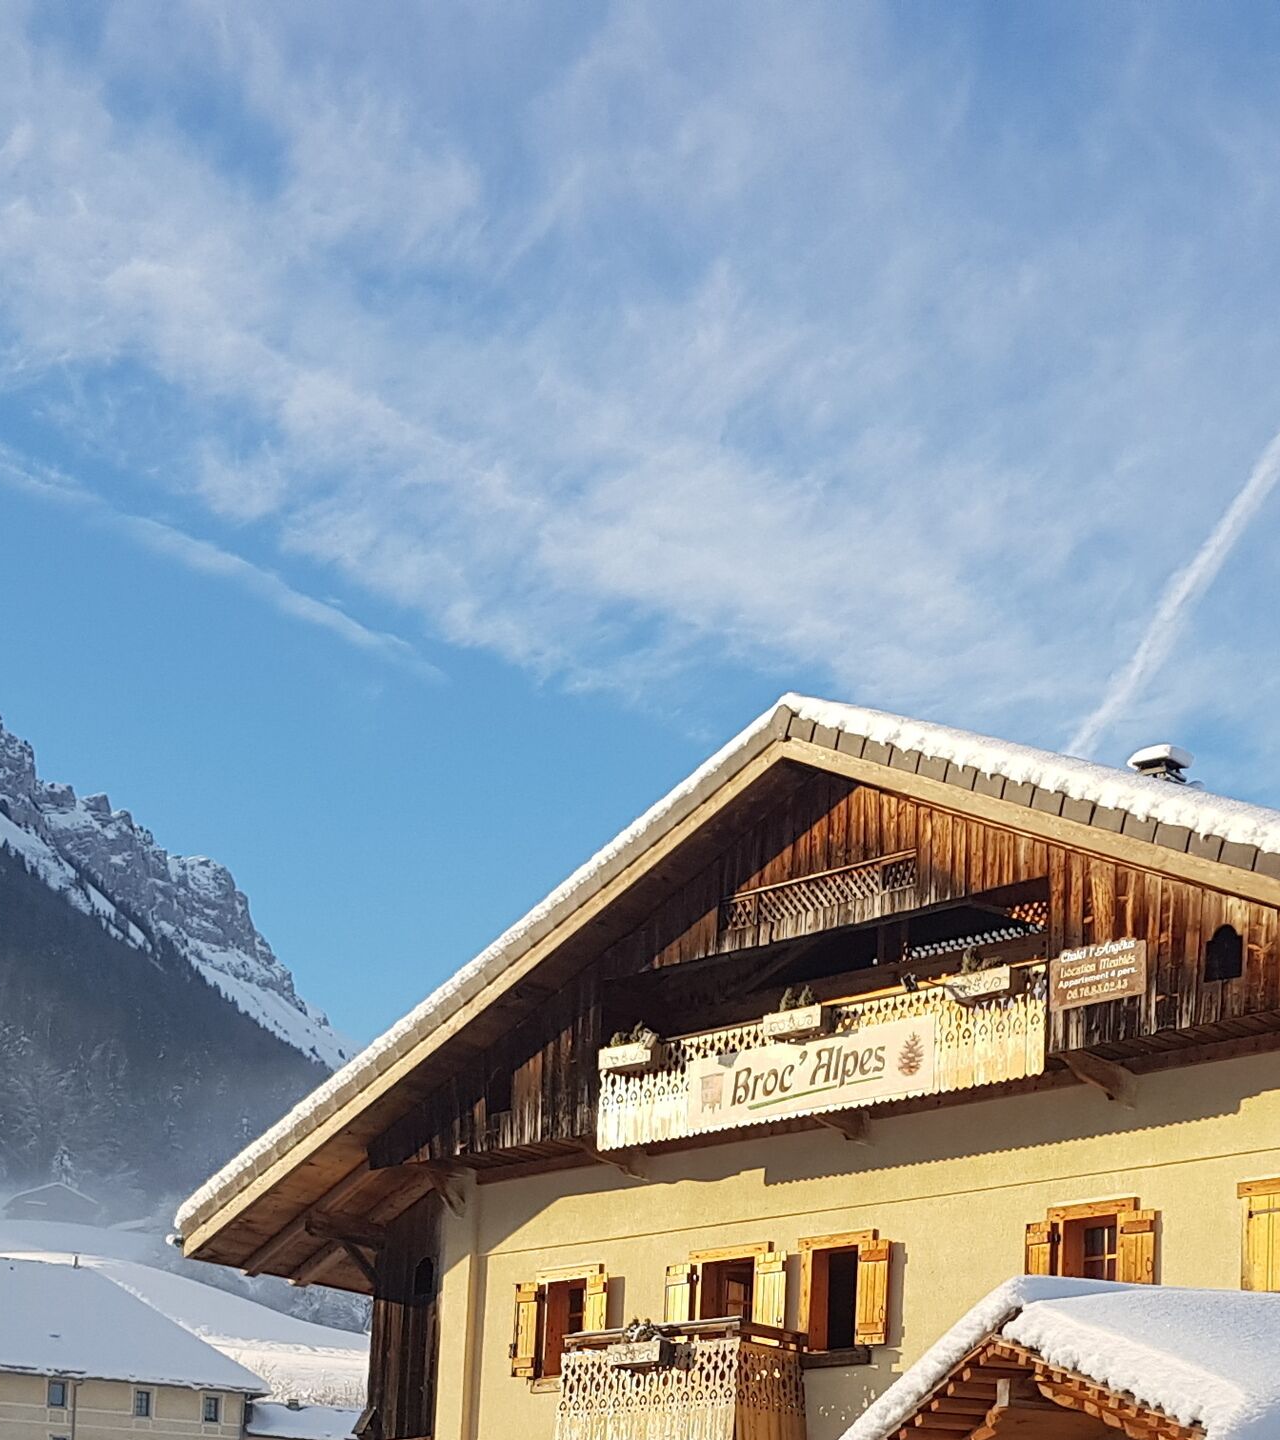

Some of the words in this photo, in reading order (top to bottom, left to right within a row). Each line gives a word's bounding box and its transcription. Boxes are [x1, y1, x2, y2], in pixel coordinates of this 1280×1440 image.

[1060, 963, 1096, 979] Location
[1100, 952, 1136, 970] Meublés
[1058, 972, 1109, 989] Appartement
[730, 1050, 808, 1107] Broc'
[809, 1045, 886, 1088] Alpes
